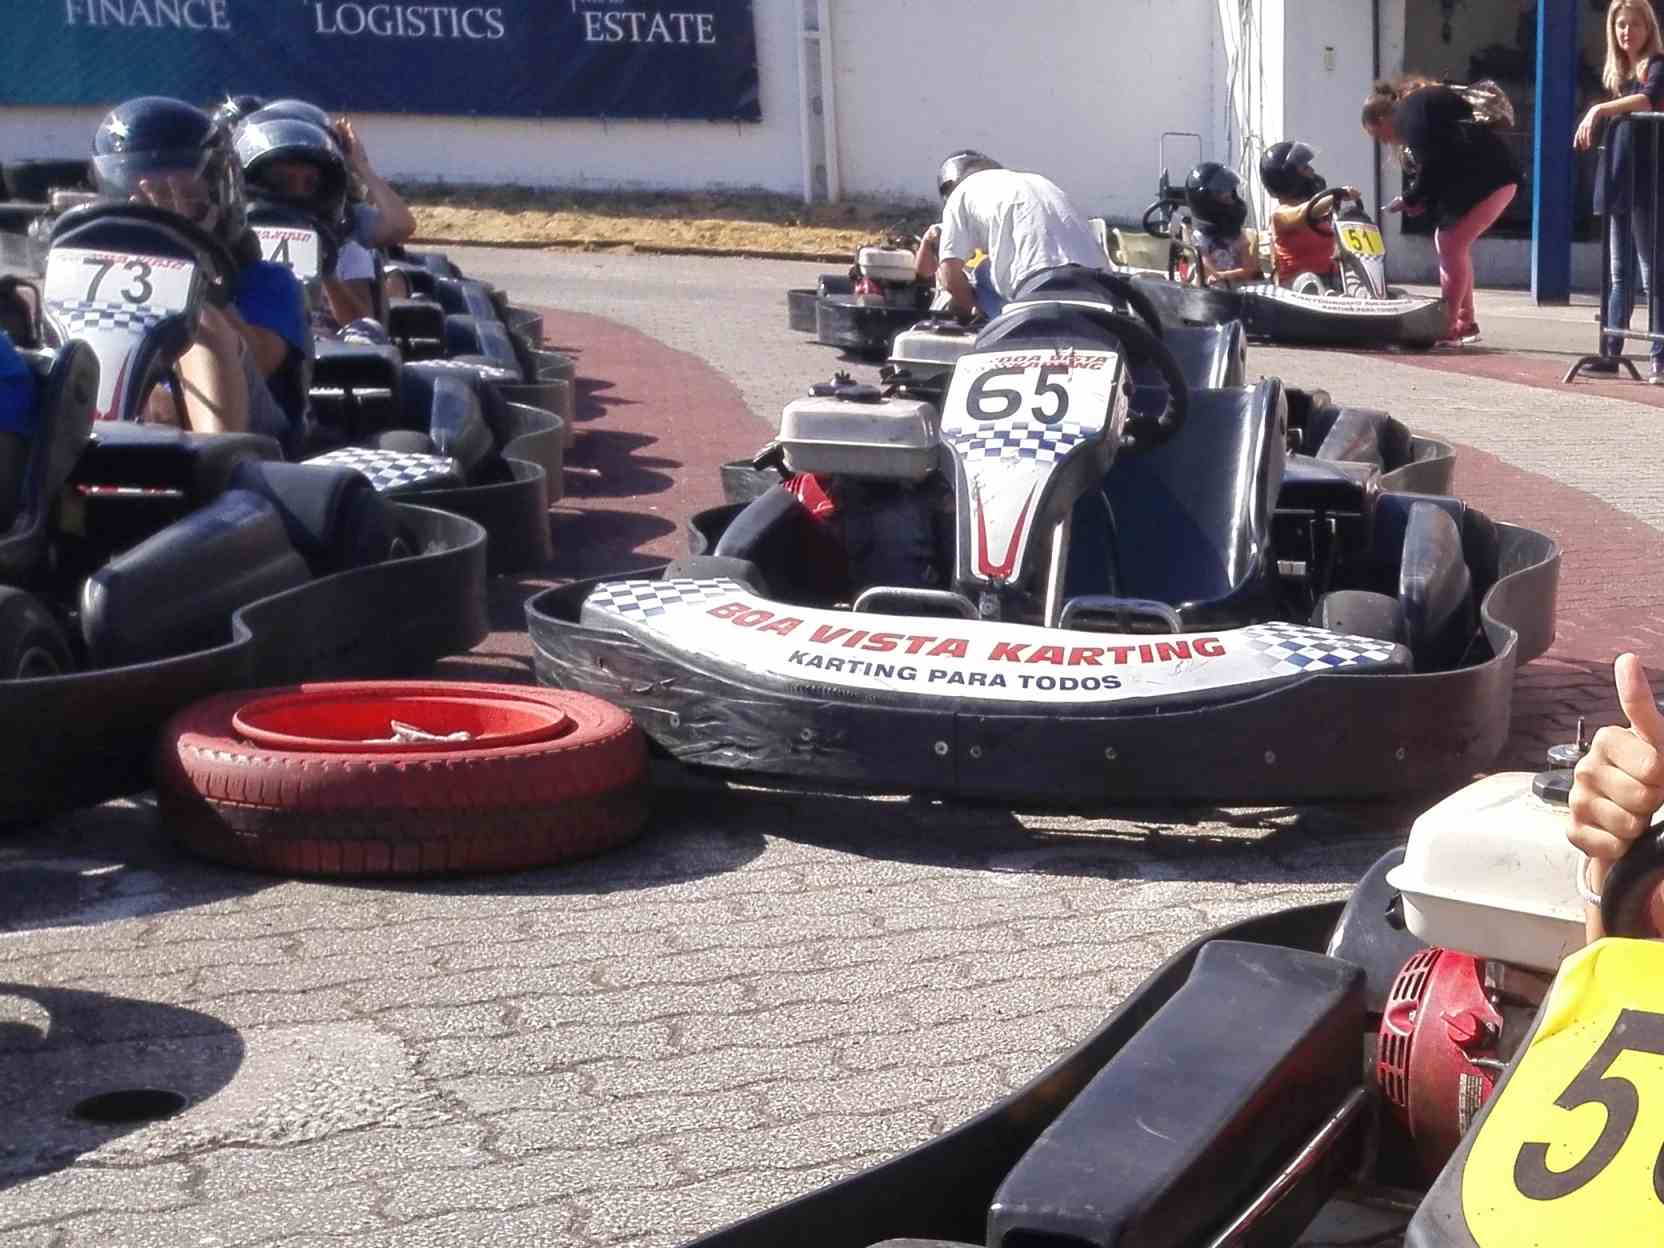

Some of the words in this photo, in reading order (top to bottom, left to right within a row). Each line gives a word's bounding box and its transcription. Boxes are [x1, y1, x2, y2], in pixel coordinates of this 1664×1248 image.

[65, 0, 231, 30] FINANCE
[314, 3, 505, 39] LOGISTICS
[583, 10, 716, 44] ESTATE
[1348, 229, 1375, 252] 51
[83, 257, 153, 304] 73
[966, 365, 1069, 424] 65
[706, 602, 804, 636] BOA
[808, 624, 969, 659] VISTA
[987, 637, 1226, 666] KARTING
[788, 650, 917, 681] KARTING
[928, 669, 1007, 687] PARA
[1018, 674, 1122, 691] TODOS
